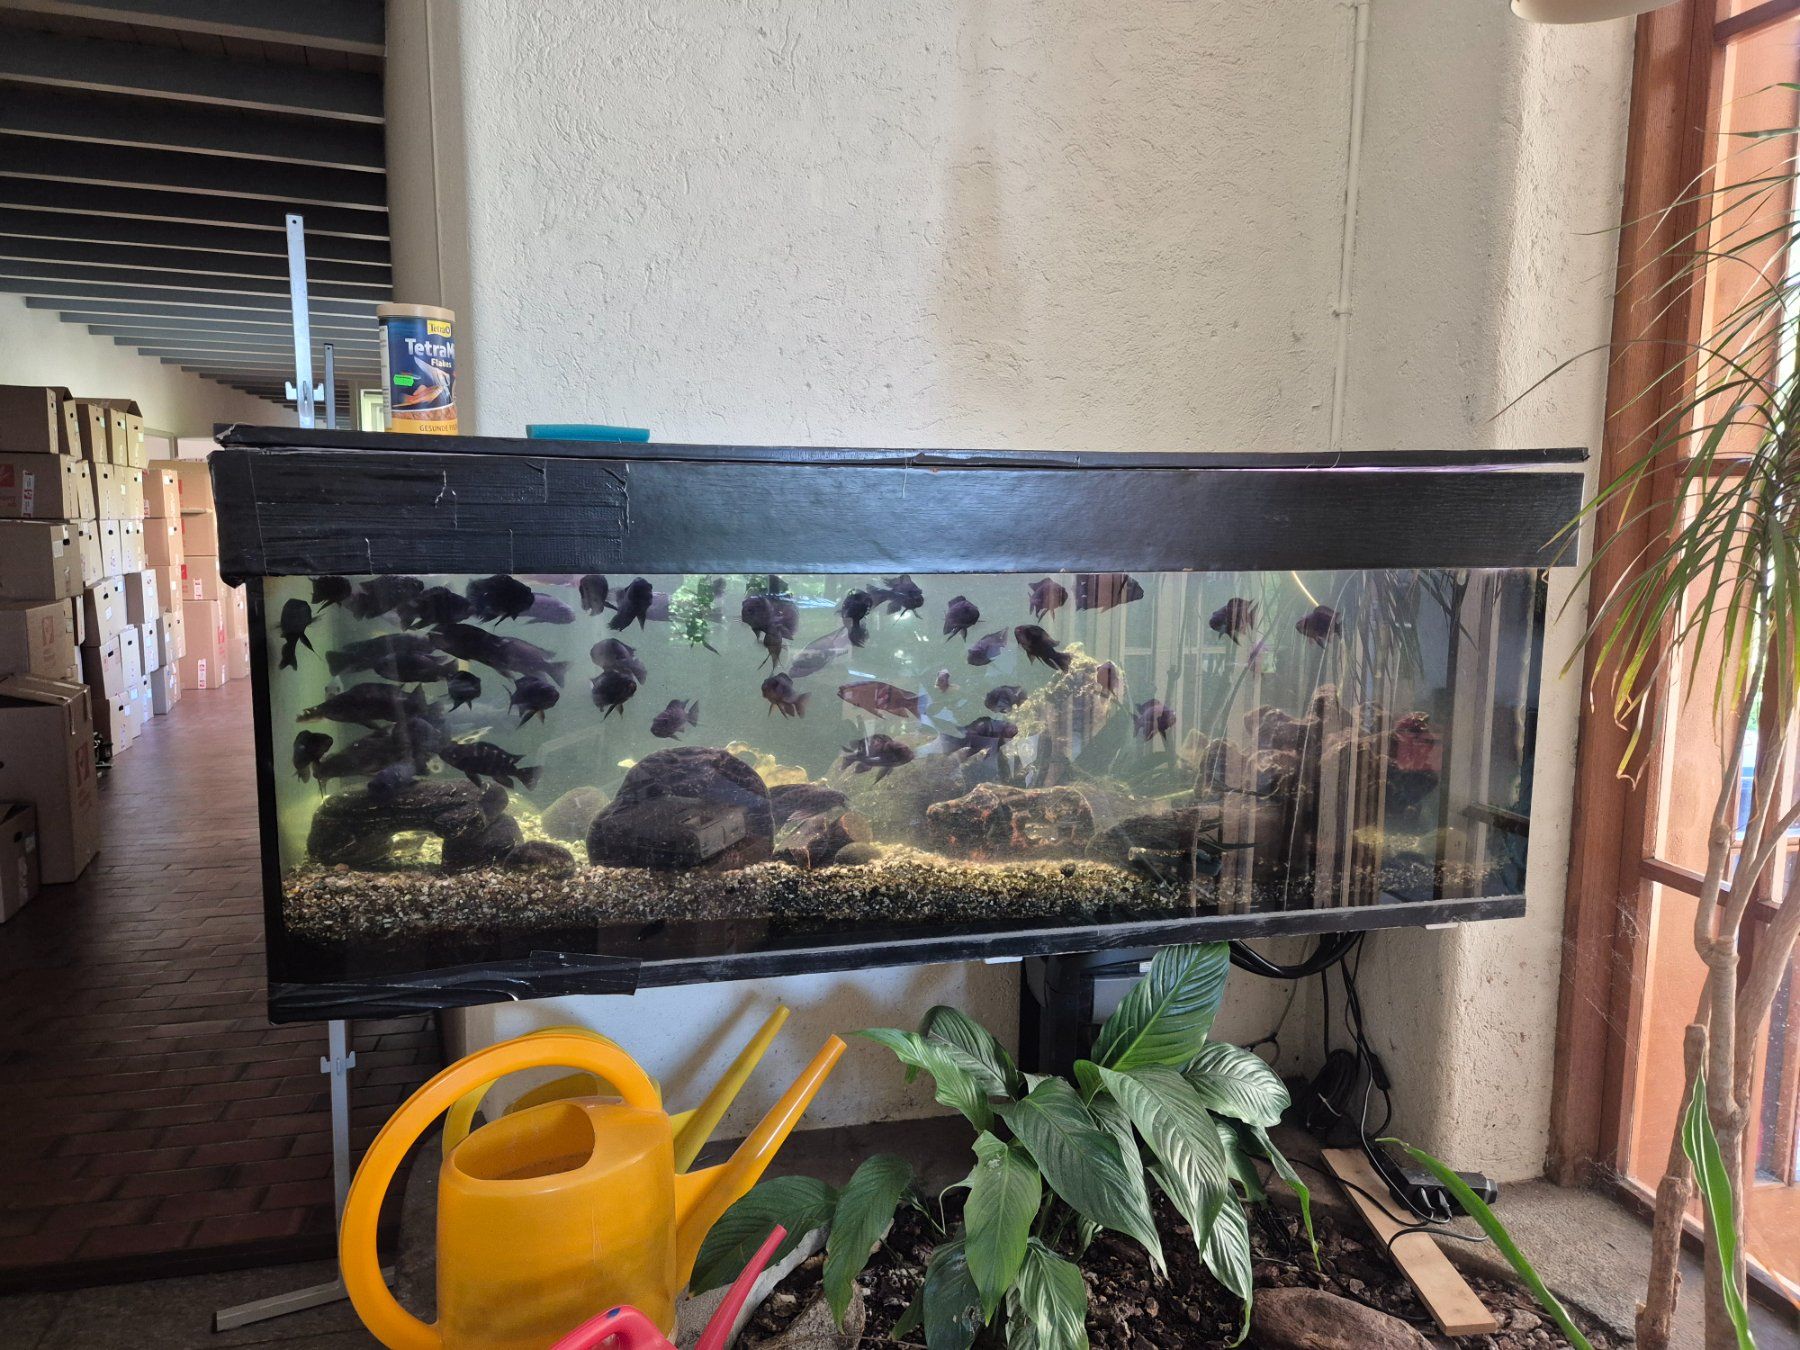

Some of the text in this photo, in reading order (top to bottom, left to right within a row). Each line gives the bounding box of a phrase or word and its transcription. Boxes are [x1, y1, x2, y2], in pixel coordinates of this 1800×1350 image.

[431, 324, 446, 334] Tetra
[431, 358, 452, 368] Flakes
[420, 424, 449, 432] GESUNDE
